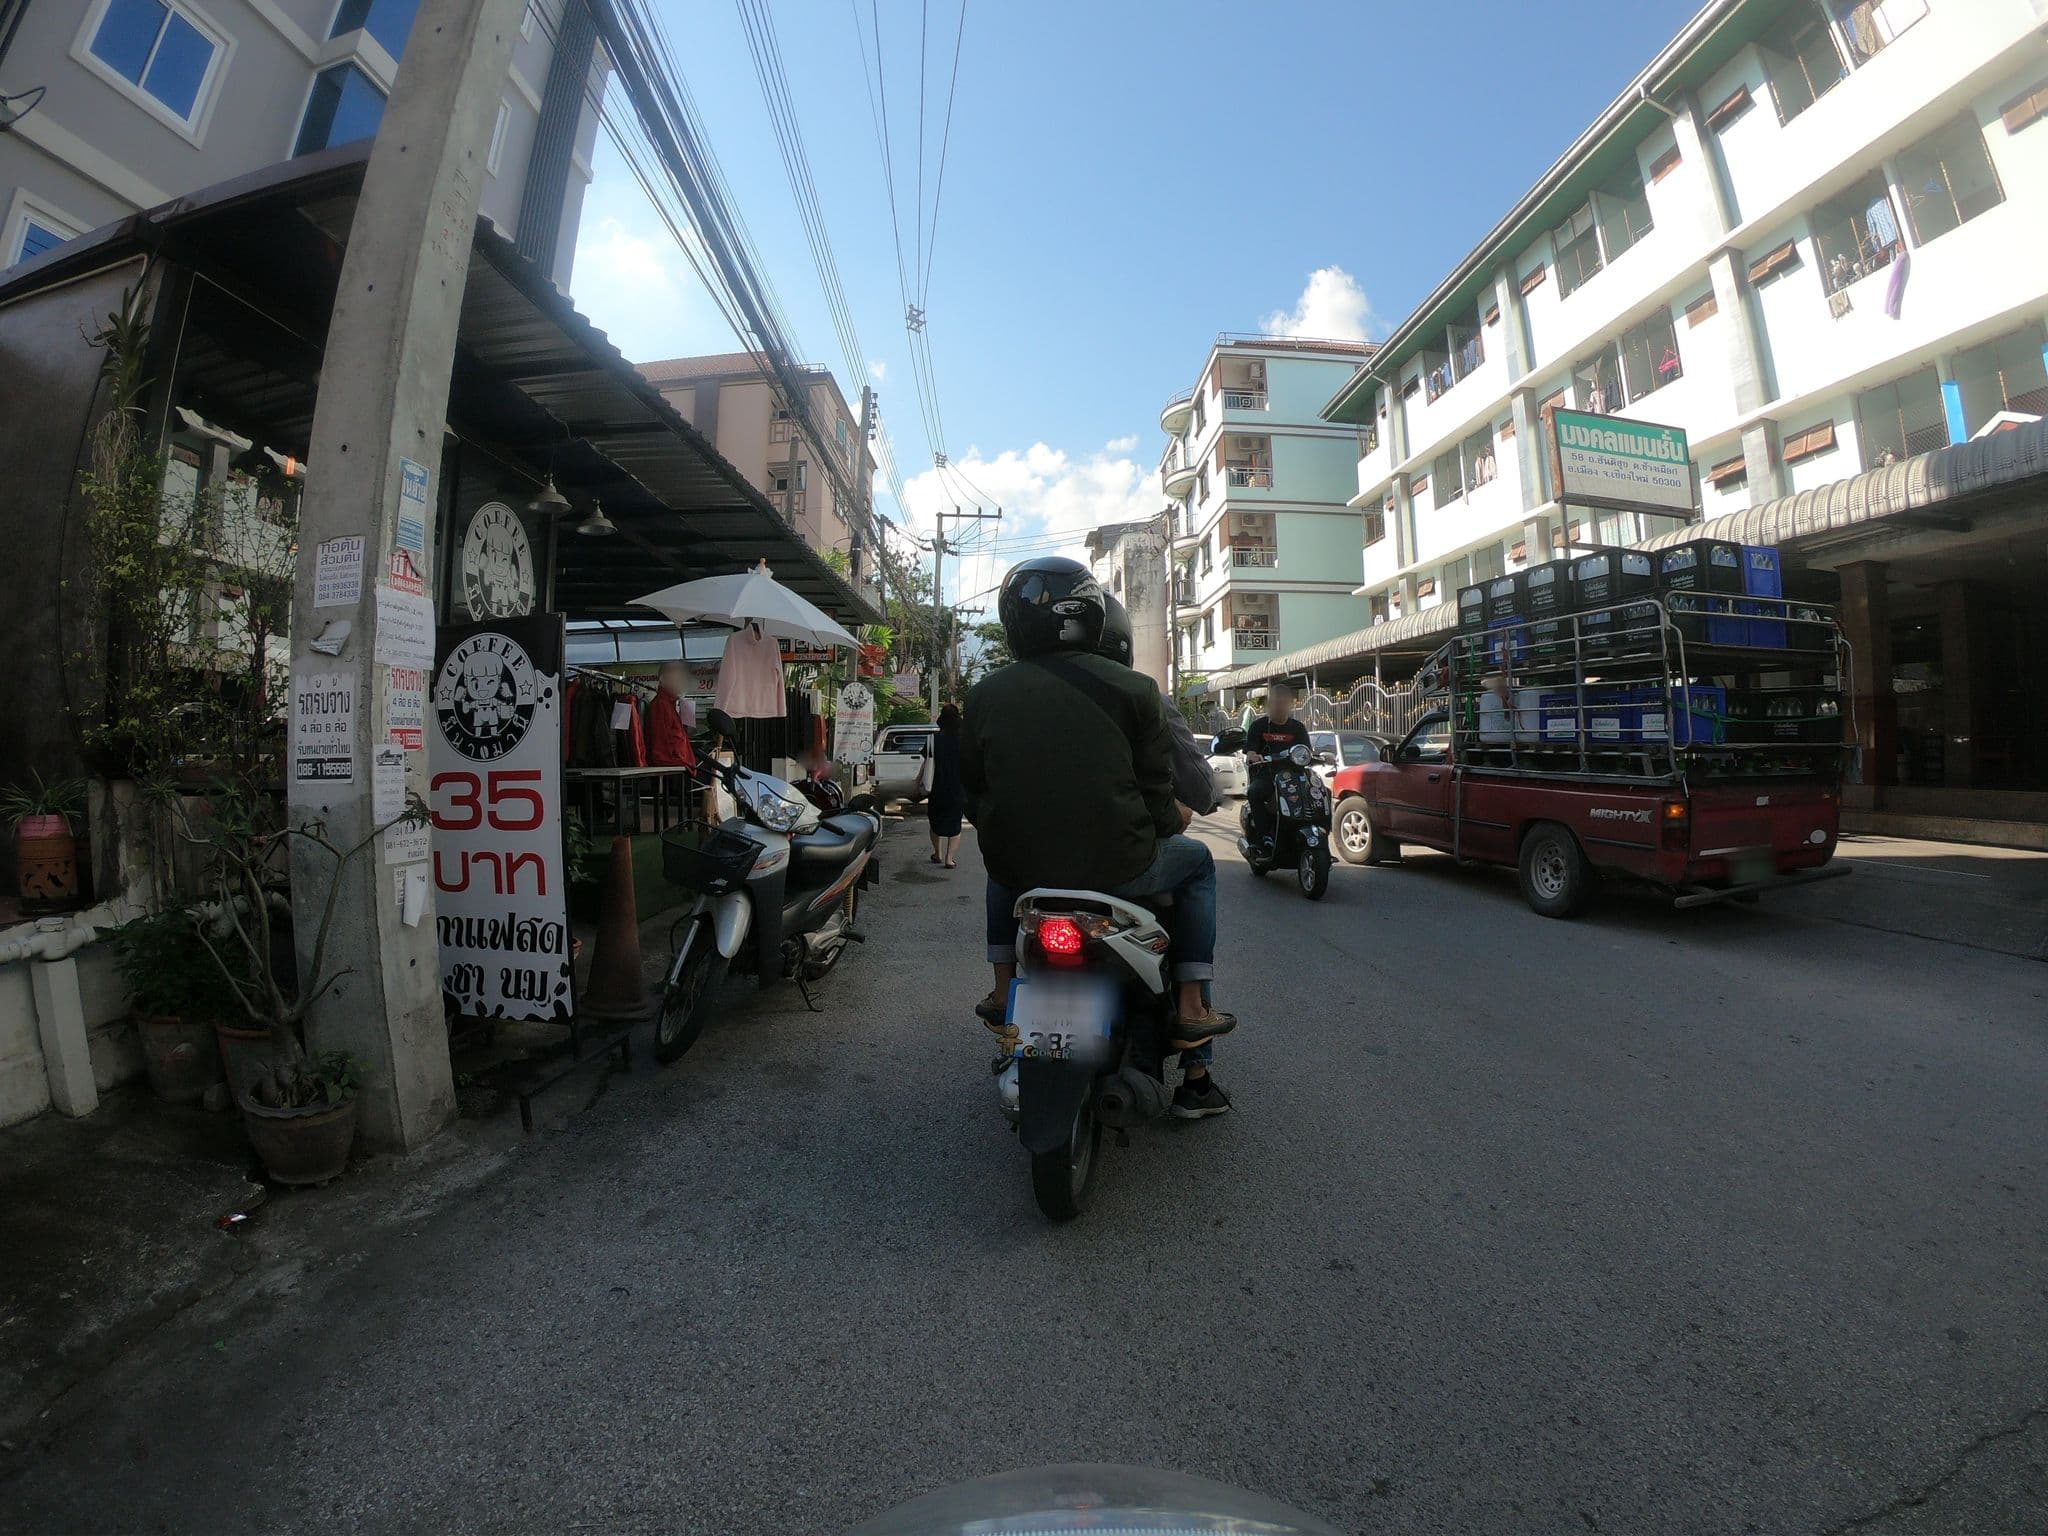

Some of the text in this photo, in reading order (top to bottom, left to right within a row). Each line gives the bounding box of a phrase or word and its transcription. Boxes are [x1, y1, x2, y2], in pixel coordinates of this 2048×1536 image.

[1561, 424, 1684, 462] มงคลแมนชั่น
[1571, 452, 1584, 462] 58
[1652, 477, 1682, 488] 50300
[474, 510, 527, 558] COFFEE
[446, 637, 526, 677] COFFEE
[697, 679, 714, 690] 20
[300, 724, 307, 733] 4
[326, 722, 331, 733] 6
[431, 769, 544, 831] 35
[433, 850, 547, 896] บาท
[436, 912, 564, 955] กาแฟสด
[452, 962, 549, 1002] ชา นม
